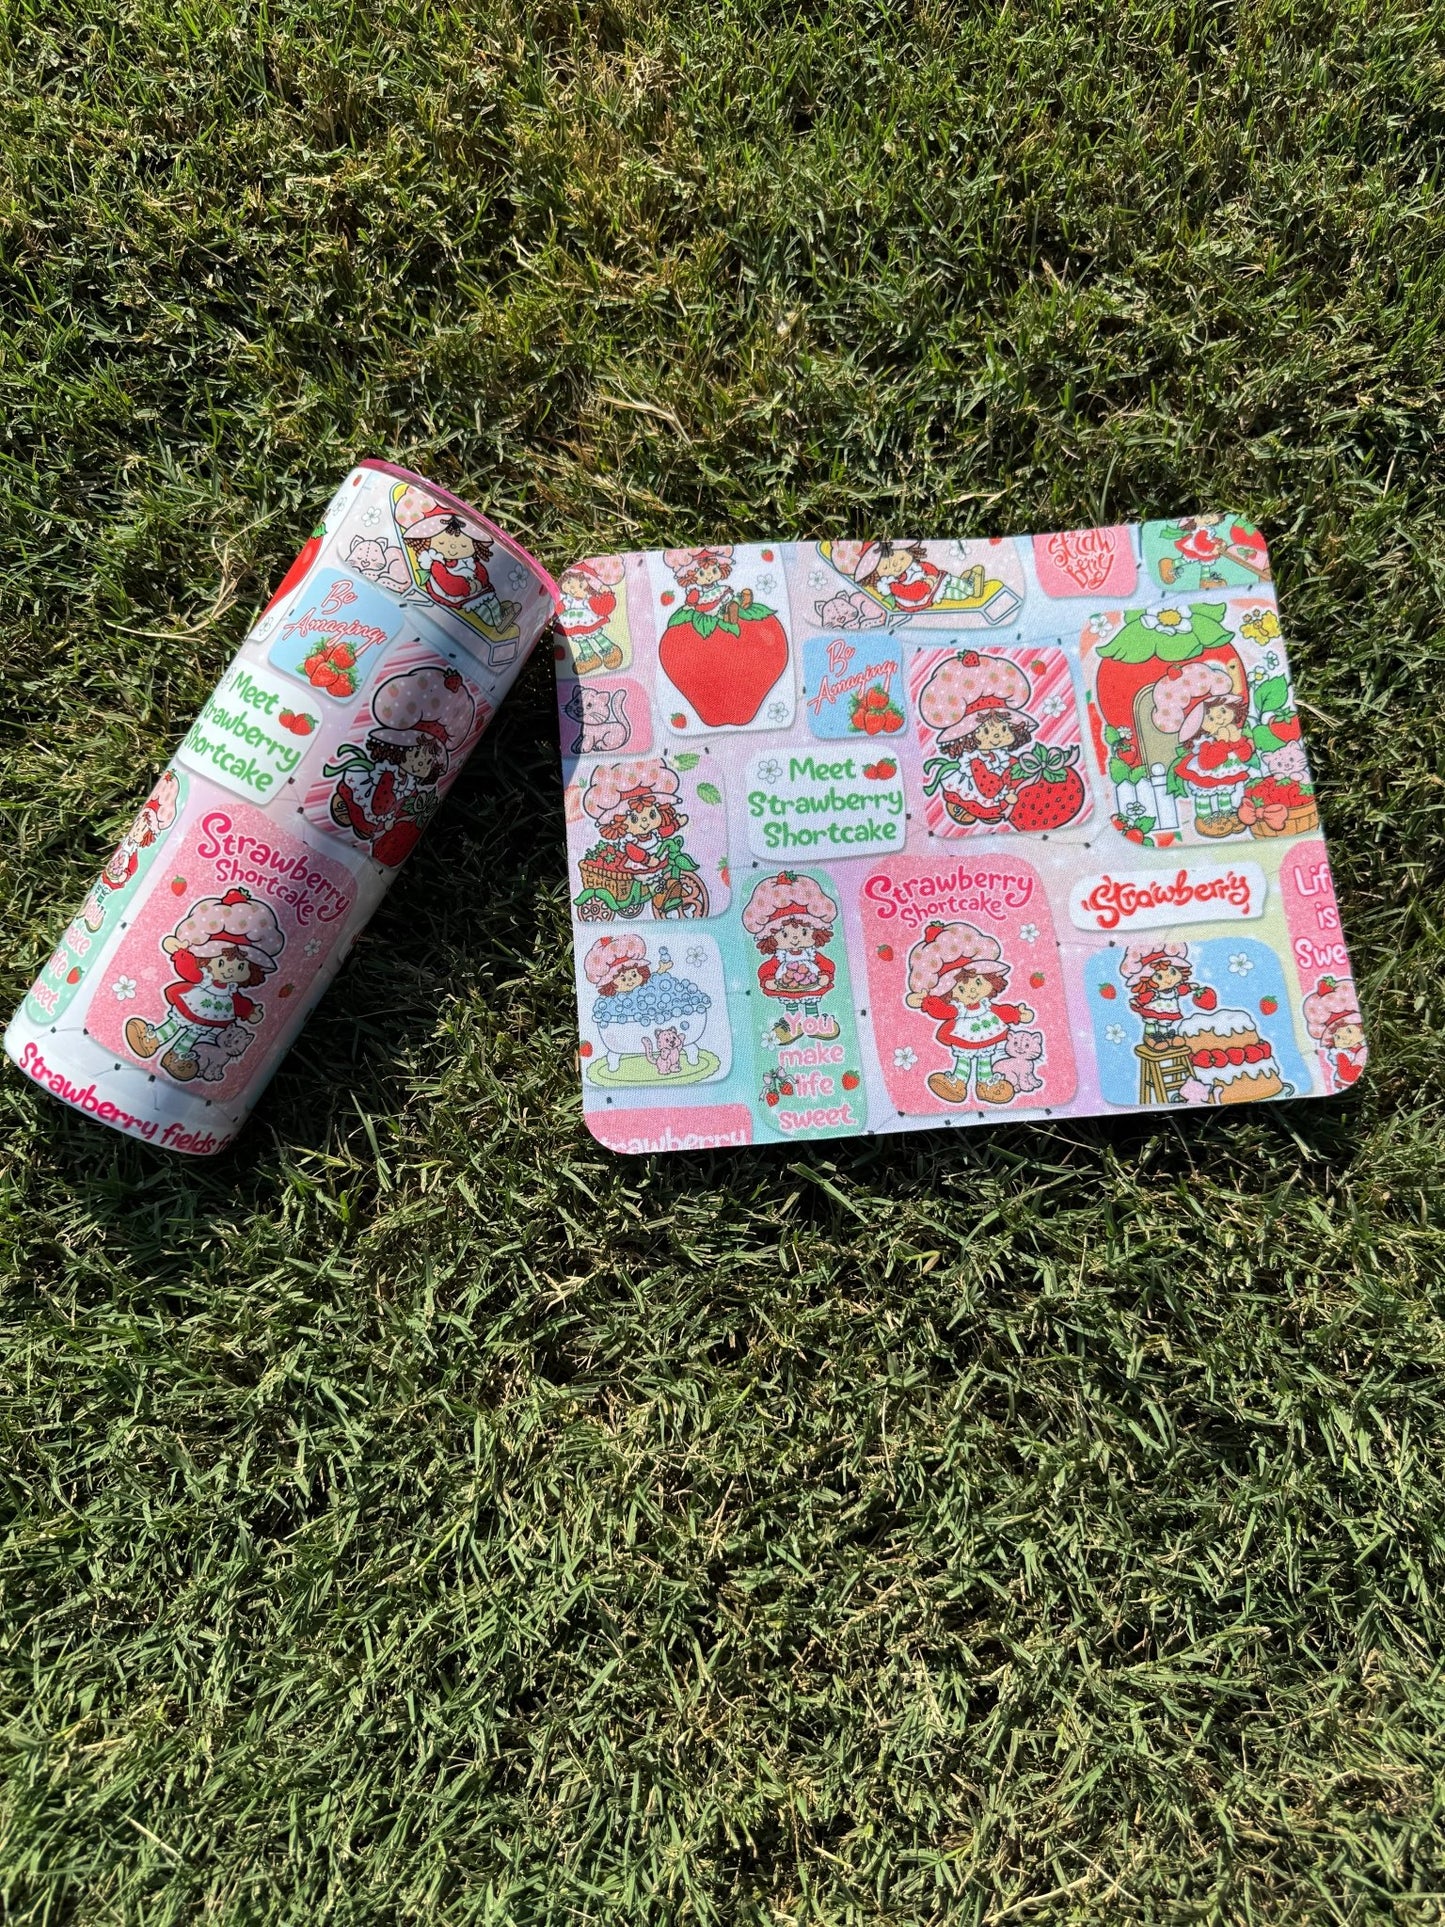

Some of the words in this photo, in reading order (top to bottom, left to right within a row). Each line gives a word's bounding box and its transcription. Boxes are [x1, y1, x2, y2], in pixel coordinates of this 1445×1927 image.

[321, 579, 358, 615] Be
[282, 607, 388, 658] Amazing
[826, 639, 856, 678] Be
[228, 671, 280, 715] Meet
[807, 660, 898, 716] Amazing
[203, 693, 302, 772] trawberry
[789, 756, 857, 782] Meet
[748, 787, 903, 817] Strawberry
[763, 818, 897, 848] Shortcake
[197, 812, 350, 922] Strawberry
[215, 858, 315, 926] Shortcake
[864, 865, 1033, 919] Strawberry
[900, 891, 1007, 928] Shortcake
[1082, 869, 1250, 929] Strawberry
[1314, 902, 1338, 930] is
[784, 1011, 835, 1036] You
[778, 1041, 845, 1066] make
[19, 1042, 159, 1139] Strawberry
[160, 1122, 217, 1155] fields
[795, 1070, 835, 1098] life
[779, 1103, 858, 1131] sweet
